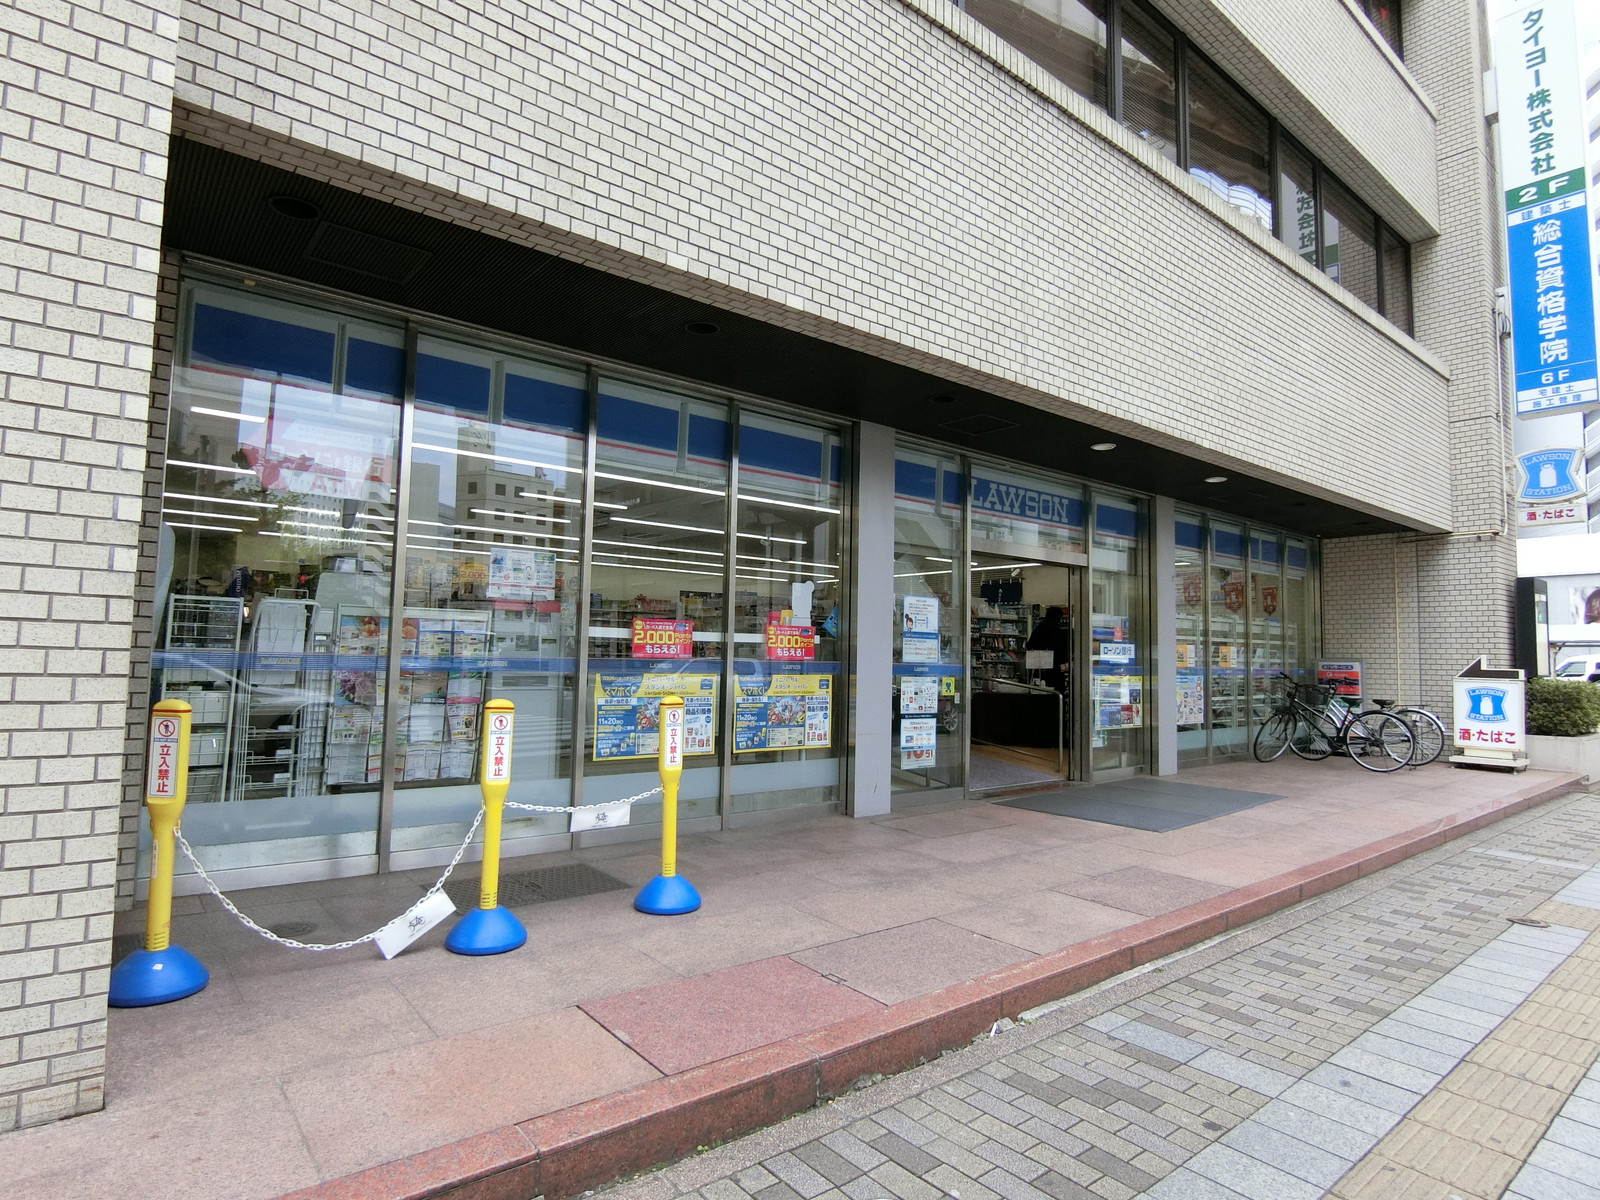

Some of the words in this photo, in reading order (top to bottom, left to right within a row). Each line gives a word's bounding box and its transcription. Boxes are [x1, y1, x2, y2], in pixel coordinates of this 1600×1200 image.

[1522, 8, 1556, 176] タイヨー株式会社
[1518, 175, 1570, 203] 2F
[1521, 199, 1571, 221] 建築士
[1532, 218, 1569, 366] 総合資格学院
[1541, 369, 1570, 384] 6F
[1538, 384, 1575, 396] 宅建士
[1532, 393, 1582, 408] 施工管理
[1523, 452, 1571, 466] LAWSON
[309, 474, 363, 497] ATM
[1525, 483, 1572, 496] STATION
[971, 478, 1069, 523] LAWSON
[633, 630, 675, 644] 2,000
[767, 635, 801, 648] 2,000
[1468, 688, 1505, 697] LAWSON
[1469, 713, 1504, 721] STATION
[670, 728, 678, 764] 立入禁止
[493, 736, 505, 777] 立入禁止
[156, 744, 171, 793] 立入禁止
